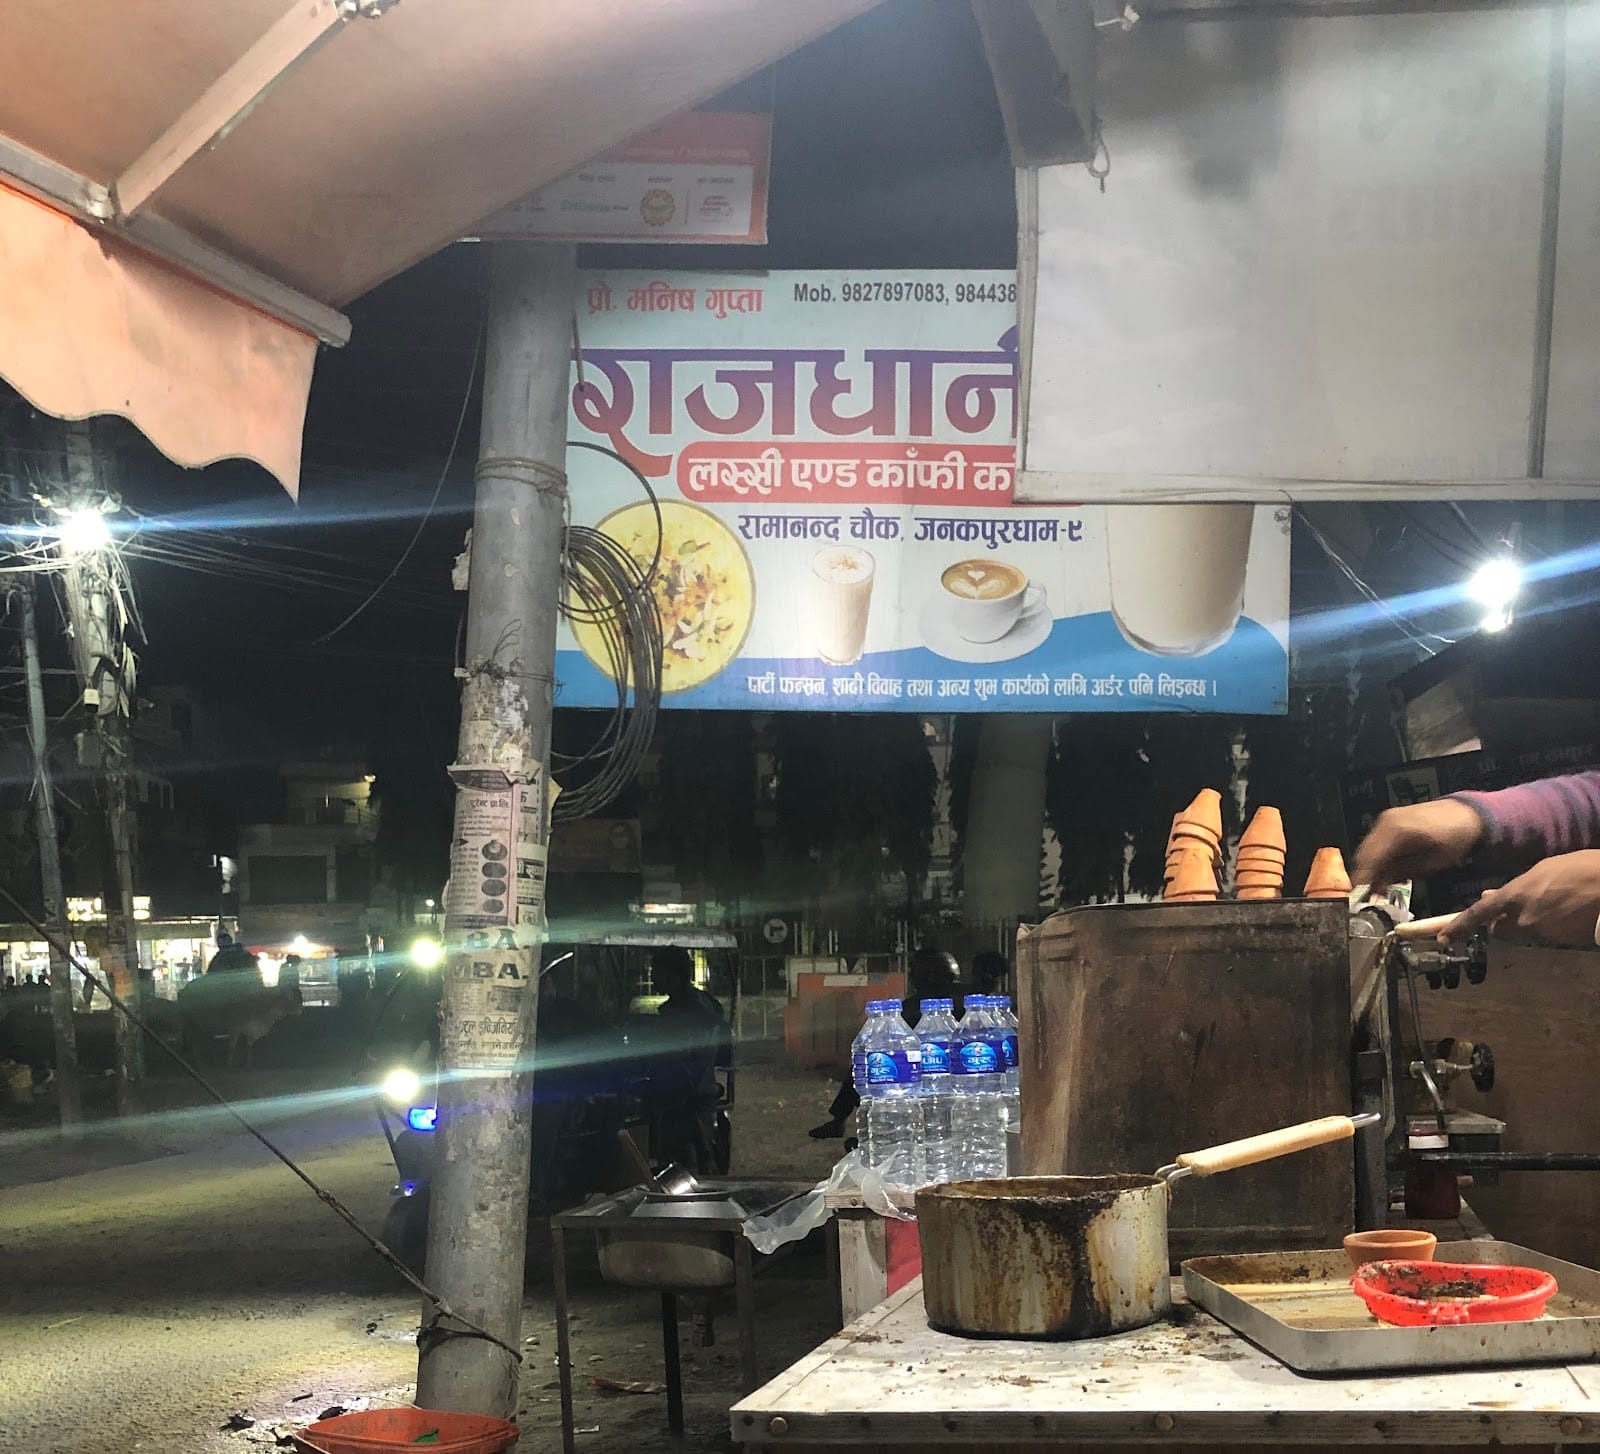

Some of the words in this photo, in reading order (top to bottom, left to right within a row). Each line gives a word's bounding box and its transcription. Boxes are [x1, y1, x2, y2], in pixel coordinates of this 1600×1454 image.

[628, 281, 696, 312] मनिष
[706, 288, 763, 319] गुप्ता
[794, 283, 836, 302] Mob.
[842, 283, 949, 305] 9827897083,
[571, 324, 1018, 477] राजधान
[791, 459, 859, 491] एण्ड
[738, 515, 841, 541] रामानन्द
[833, 673, 863, 695] शादी
[867, 672, 903, 697] विवाह
[907, 679, 933, 697] तथा
[937, 679, 970, 697] अन्य
[1002, 673, 1050, 696] कार्यको
[1054, 673, 1087, 696] लागि
[1091, 674, 1124, 696] अर्डर
[1129, 673, 1154, 696] पनि
